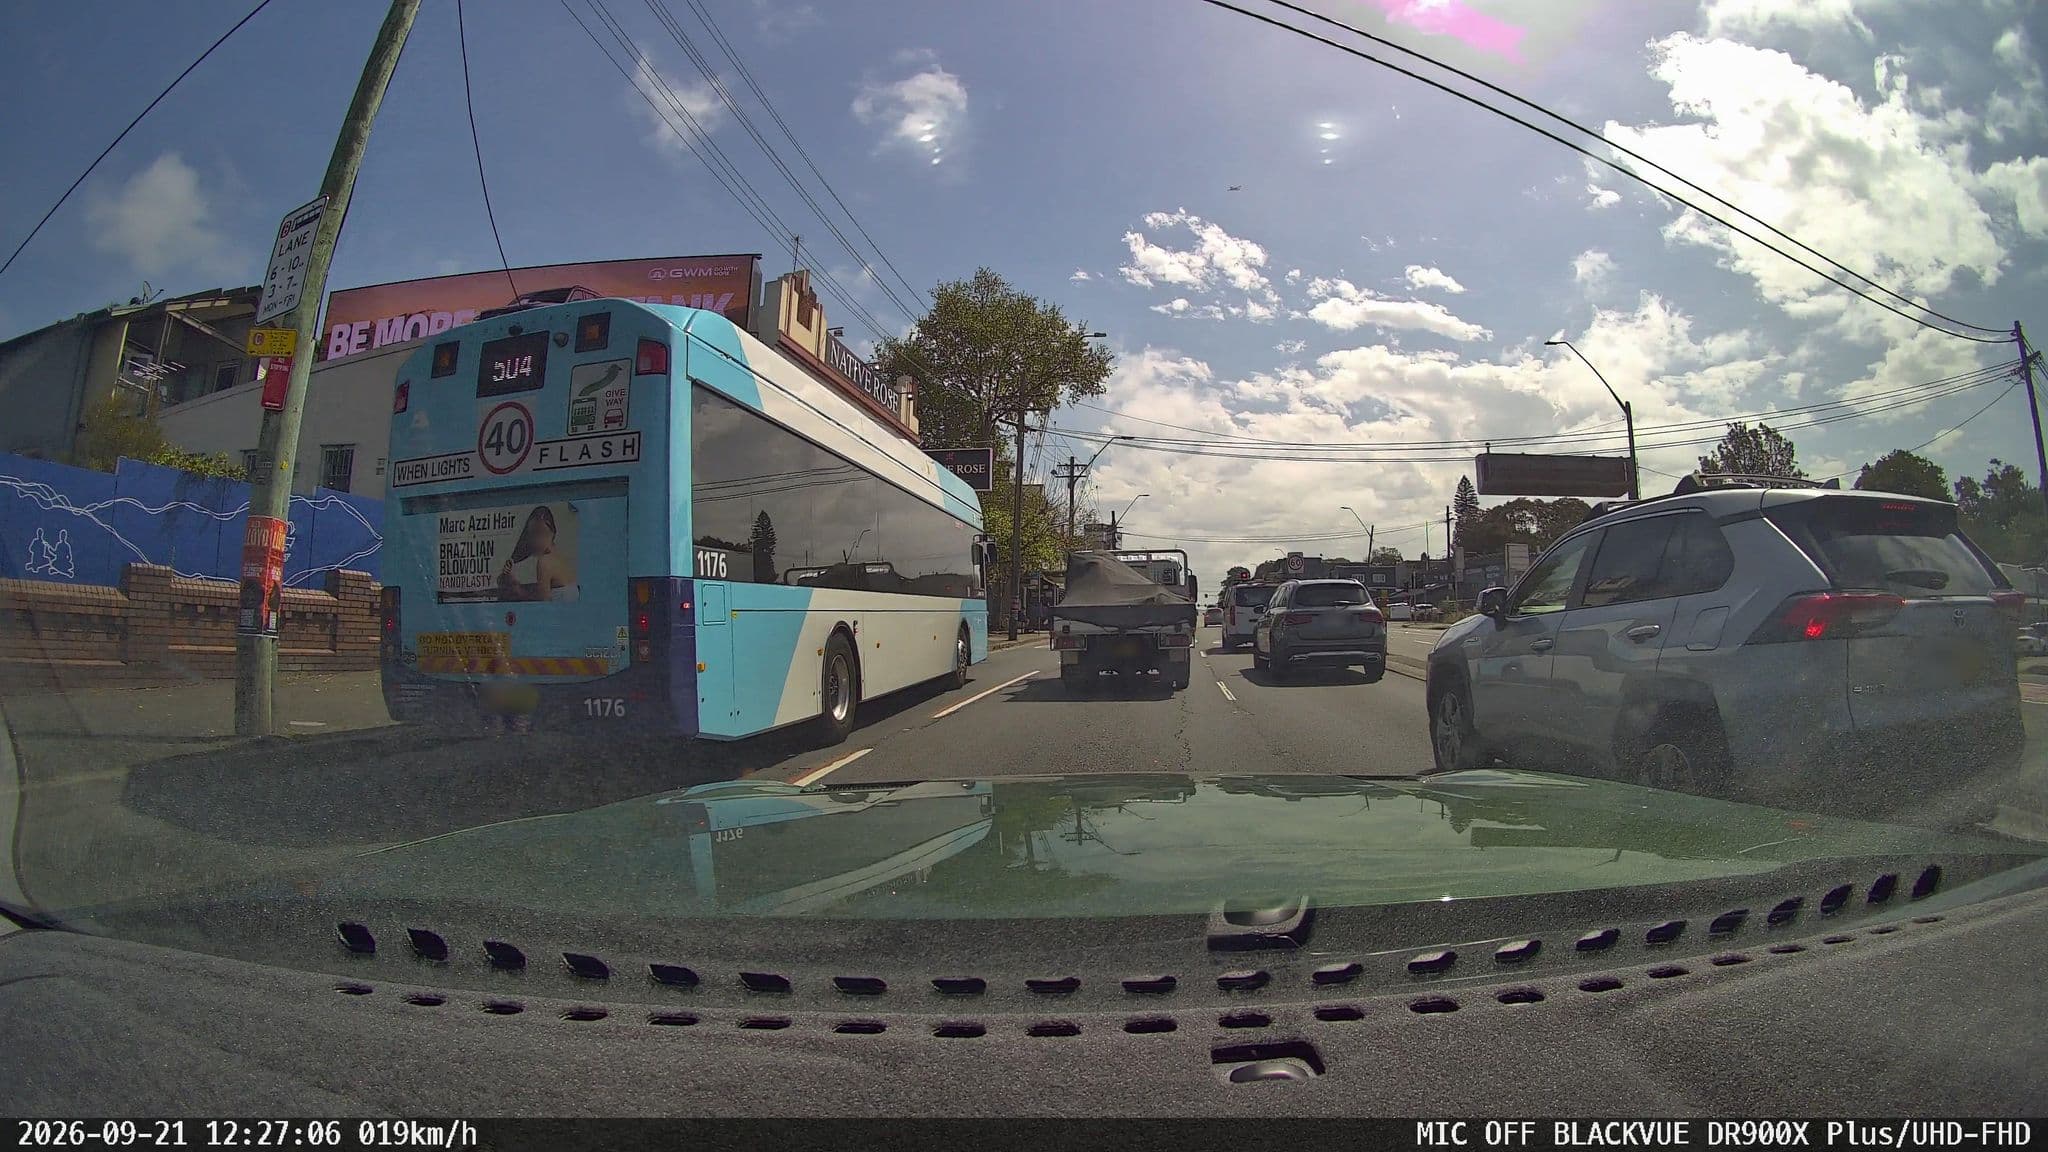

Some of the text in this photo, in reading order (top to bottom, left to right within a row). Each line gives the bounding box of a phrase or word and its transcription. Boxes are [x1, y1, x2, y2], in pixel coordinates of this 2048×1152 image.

[278, 231, 310, 257] LANE
[270, 265, 278, 281] 6
[670, 268, 713, 278] GWM
[268, 284, 276, 298] 3
[327, 320, 371, 361] BE
[830, 340, 899, 413] NATIVE ROSE
[605, 388, 626, 398] GIVE
[605, 397, 624, 406] WAY
[484, 418, 526, 456] 40
[539, 438, 636, 464] FLASH
[397, 457, 471, 482] WHEN LIGHTS
[957, 463, 986, 473] ROSE
[439, 511, 516, 534] Marc Azzi Hair
[440, 540, 495, 559] BRAZILIAN
[439, 557, 491, 576] BLOWOUT
[697, 550, 728, 579] 1176
[1291, 558, 1301, 567] 60
[440, 575, 492, 589] NANOPLASTY
[584, 698, 626, 718] 1176
